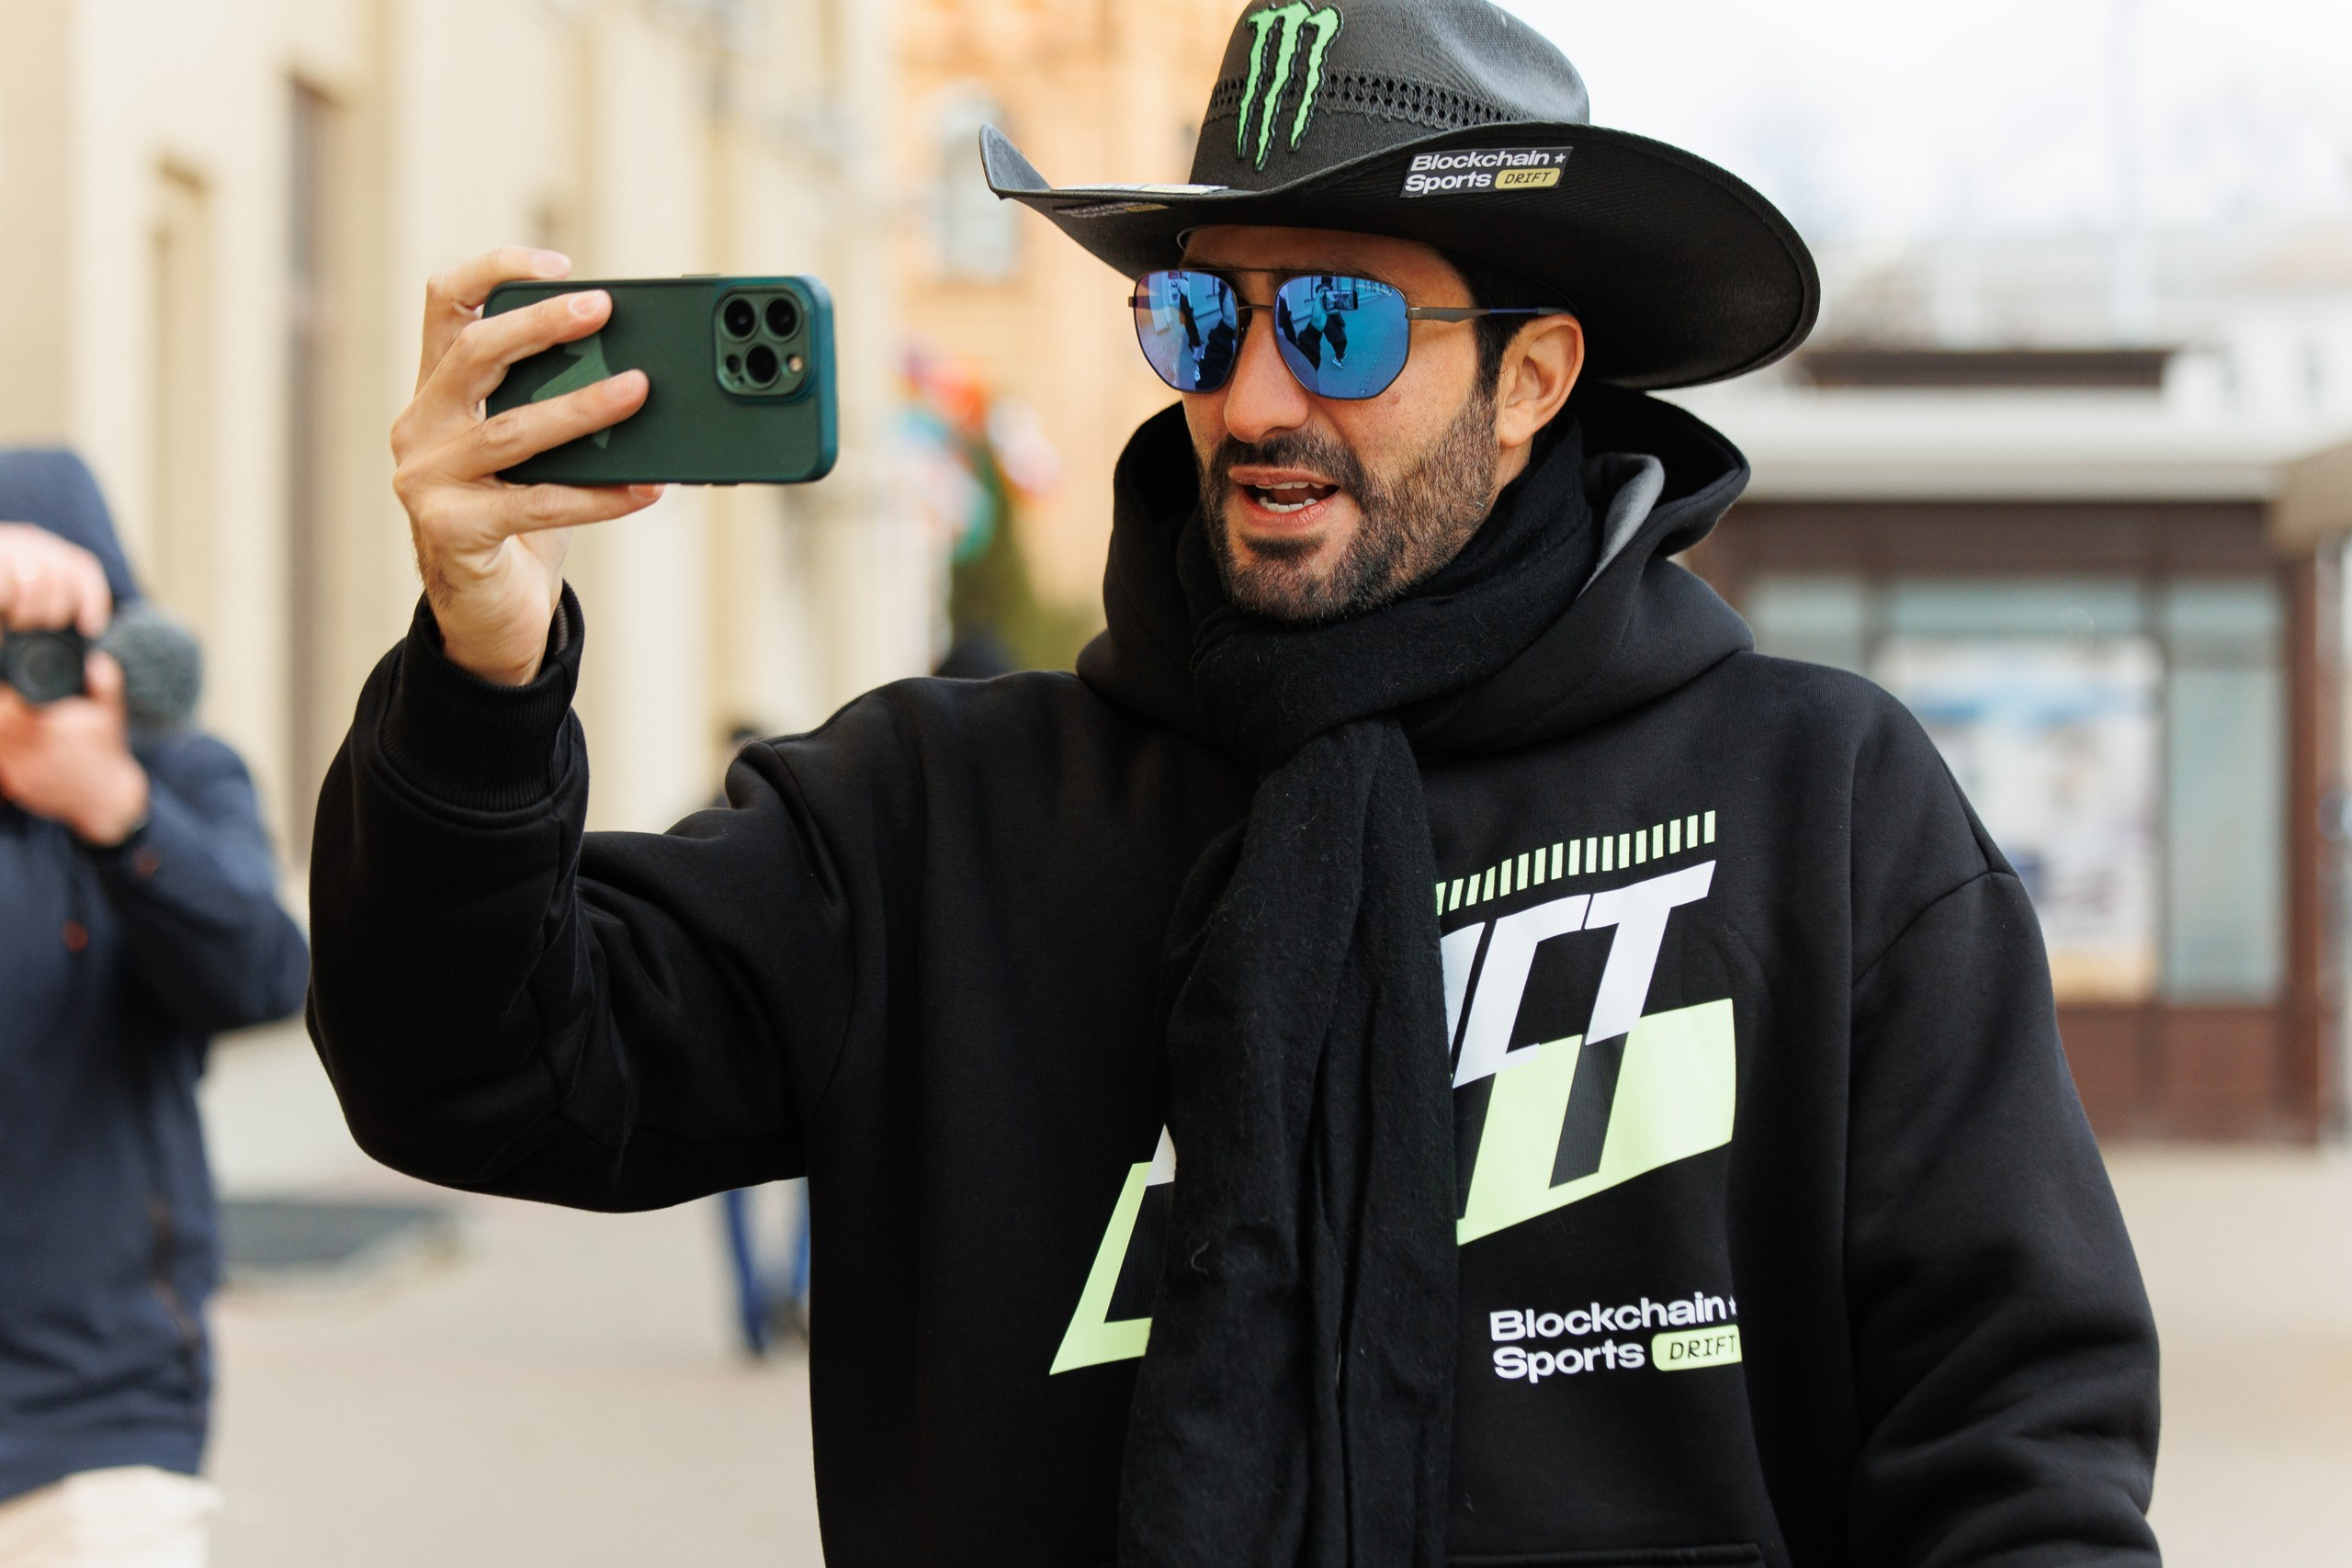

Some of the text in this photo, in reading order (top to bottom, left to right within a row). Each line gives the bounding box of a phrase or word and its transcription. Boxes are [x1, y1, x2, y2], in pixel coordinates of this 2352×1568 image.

[1410, 151, 1550, 172] Blockchain
[1405, 171, 1552, 194] Sports DRIFT
[1490, 1292, 1726, 1341] Blockchain
[1493, 1334, 1736, 1383] Sports DRIFT
